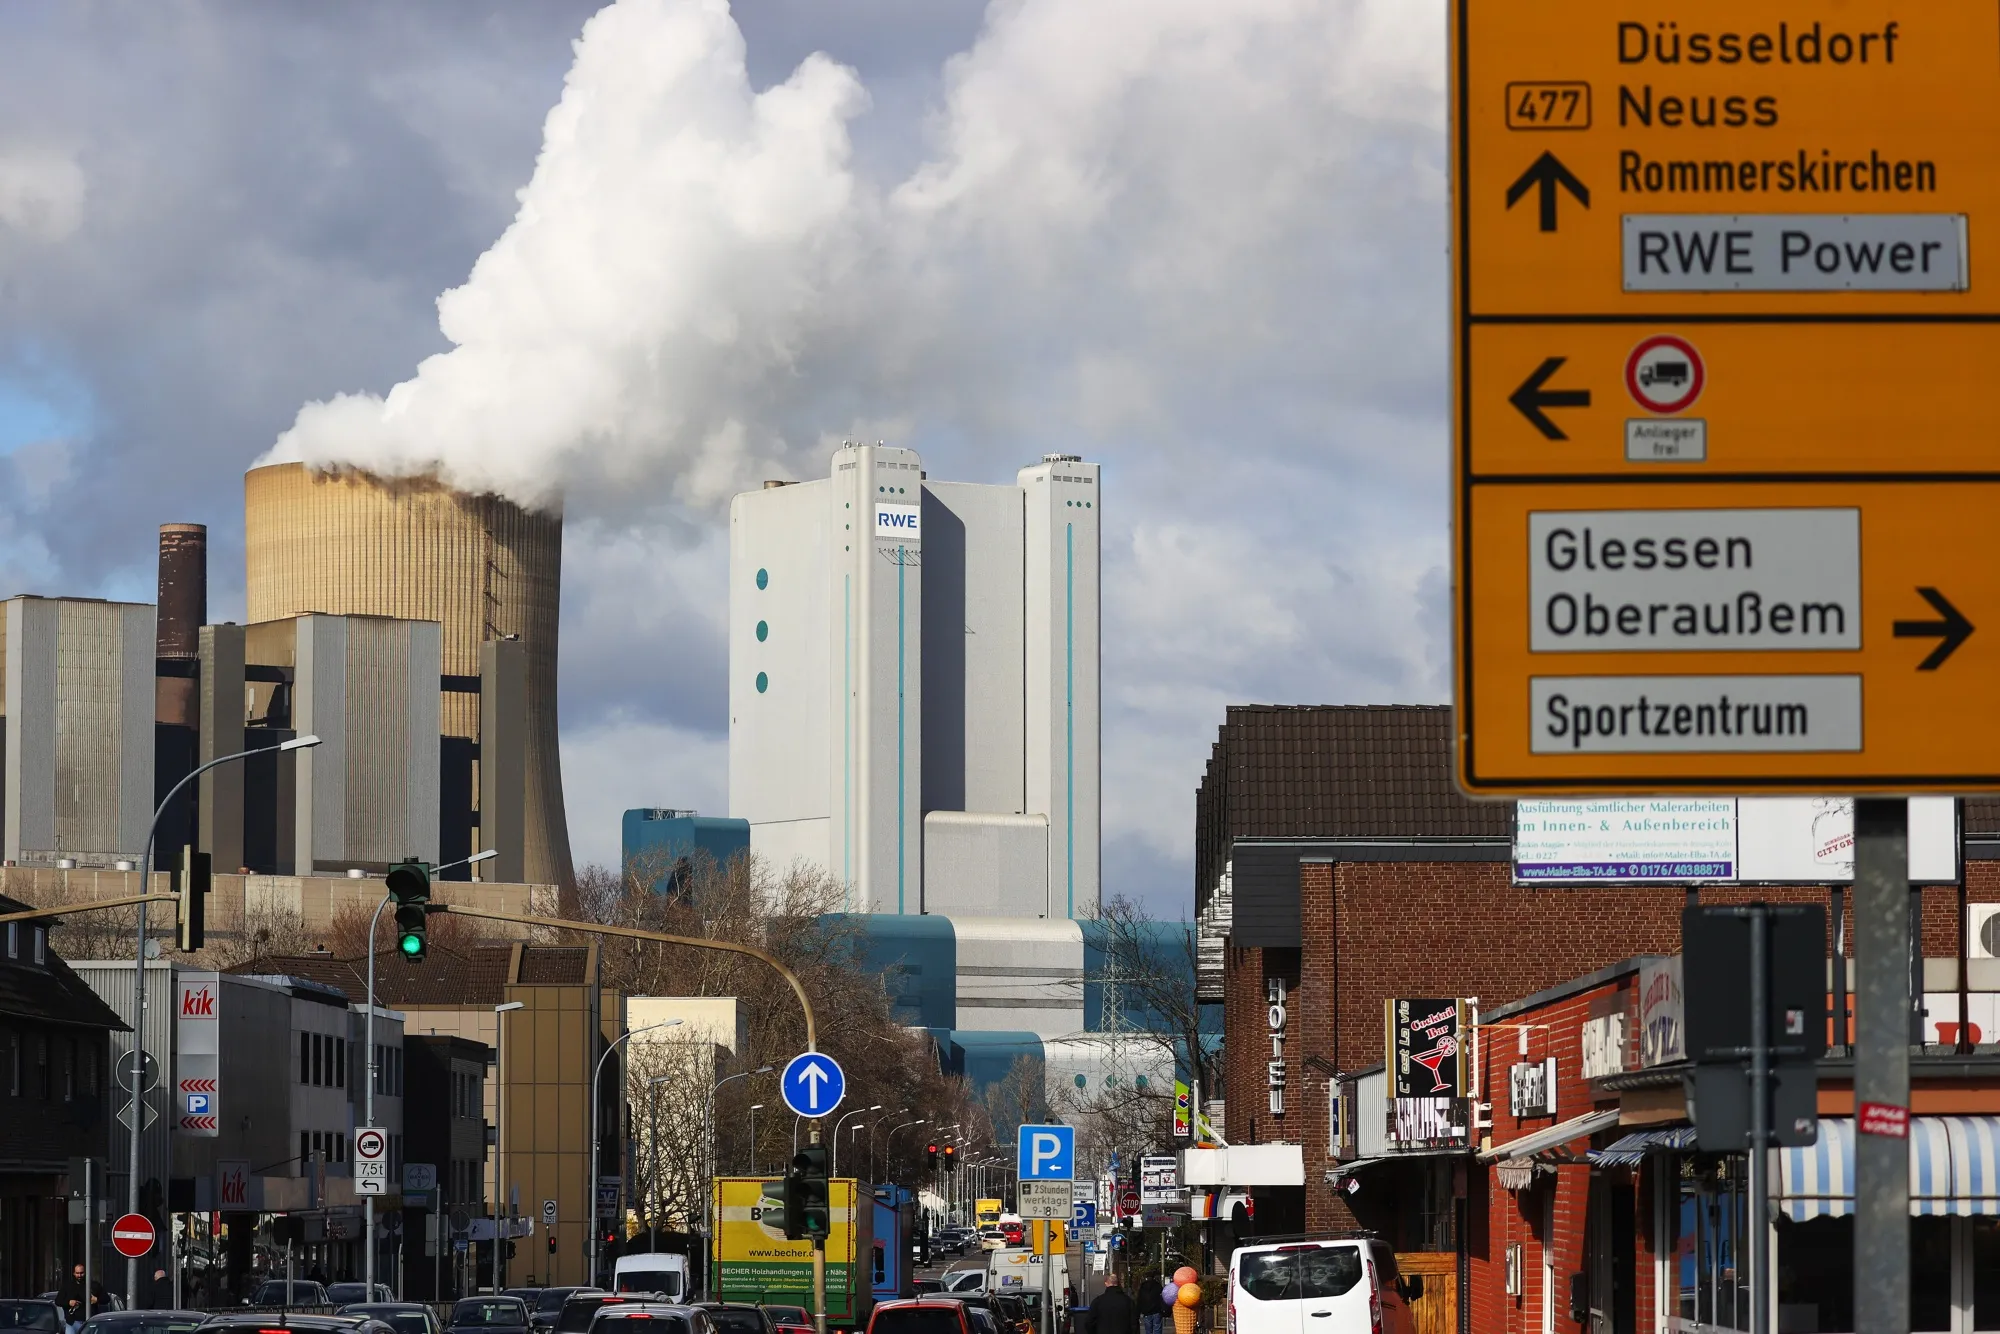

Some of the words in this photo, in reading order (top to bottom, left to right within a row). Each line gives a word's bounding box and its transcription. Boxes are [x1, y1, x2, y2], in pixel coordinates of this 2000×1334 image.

[1617, 22, 1898, 64] Düsseldorf
[1516, 90, 1580, 122] 477
[1619, 85, 1779, 127] Neuss
[1620, 150, 1937, 192] Rommerskirchen
[1638, 231, 1754, 274] RWE
[1781, 231, 1941, 274] Power
[1634, 425, 1696, 442] Anlieger
[1653, 442, 1679, 456] frei
[878, 513, 917, 529] RWE
[1546, 528, 1753, 571] Glessen
[1546, 592, 1845, 637] Oberaußem
[1547, 694, 1808, 749] Sportzentrum
[1518, 801, 1583, 815] Ausführung
[1586, 801, 1645, 813] sämtlicher
[1650, 801, 1730, 812] Malerarbeiten
[1518, 820, 1535, 832] im
[1544, 820, 1592, 832] Innen-
[1600, 820, 1609, 831] &
[1623, 818, 1730, 831] Außenbereich
[1817, 844, 1839, 858] CITY
[1522, 866, 1617, 877] www.Maler-Elba-TA.de
[182, 986, 215, 1015] kik
[1410, 1005, 1456, 1031] Cocktail
[1426, 1024, 1449, 1040] Bar
[1268, 978, 1287, 1114] HOTEL
[190, 1096, 206, 1113] P
[1032, 1133, 1061, 1175] P
[361, 1163, 377, 1176] 7,5
[221, 1166, 247, 1204] kik
[1024, 1196, 1068, 1207] werktags
[1122, 1200, 1139, 1209] STOP
[1073, 1206, 1087, 1227] P
[751, 1268, 804, 1277] Holzhandlungen
